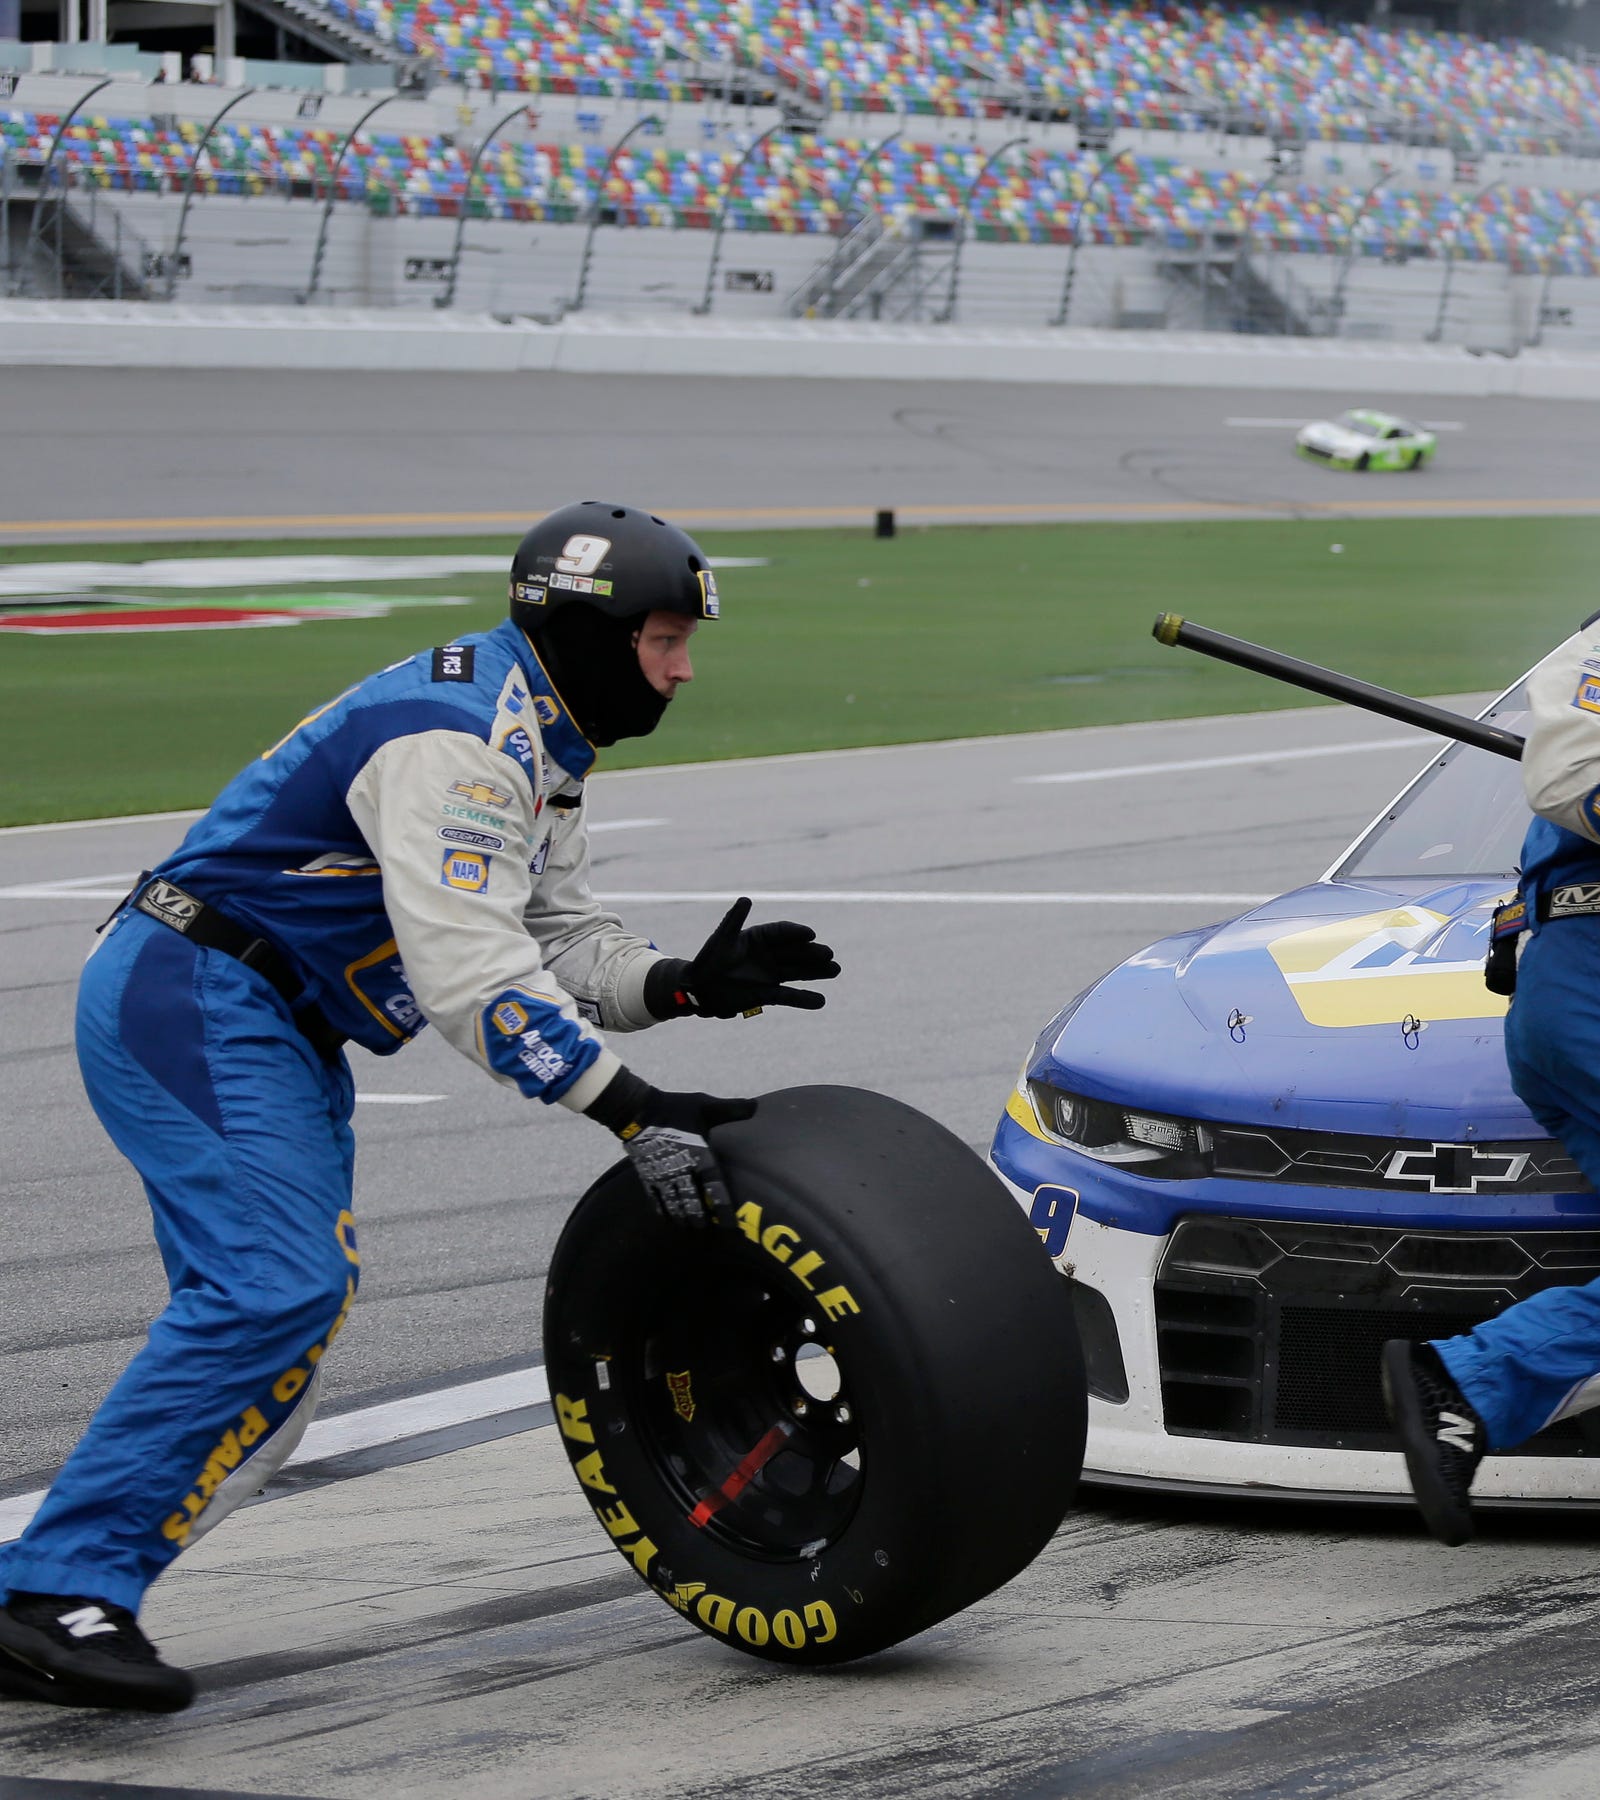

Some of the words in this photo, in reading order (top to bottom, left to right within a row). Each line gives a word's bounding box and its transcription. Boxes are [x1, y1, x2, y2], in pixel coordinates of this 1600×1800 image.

[555, 534, 611, 575] 9
[442, 804, 506, 830] SIEMENS
[443, 829, 501, 848] FREIGHTLINER
[451, 861, 480, 881] NAPA
[518, 1050, 555, 1083] CENTER
[1029, 1184, 1080, 1261] 9
[735, 1201, 861, 1322] AGLE
